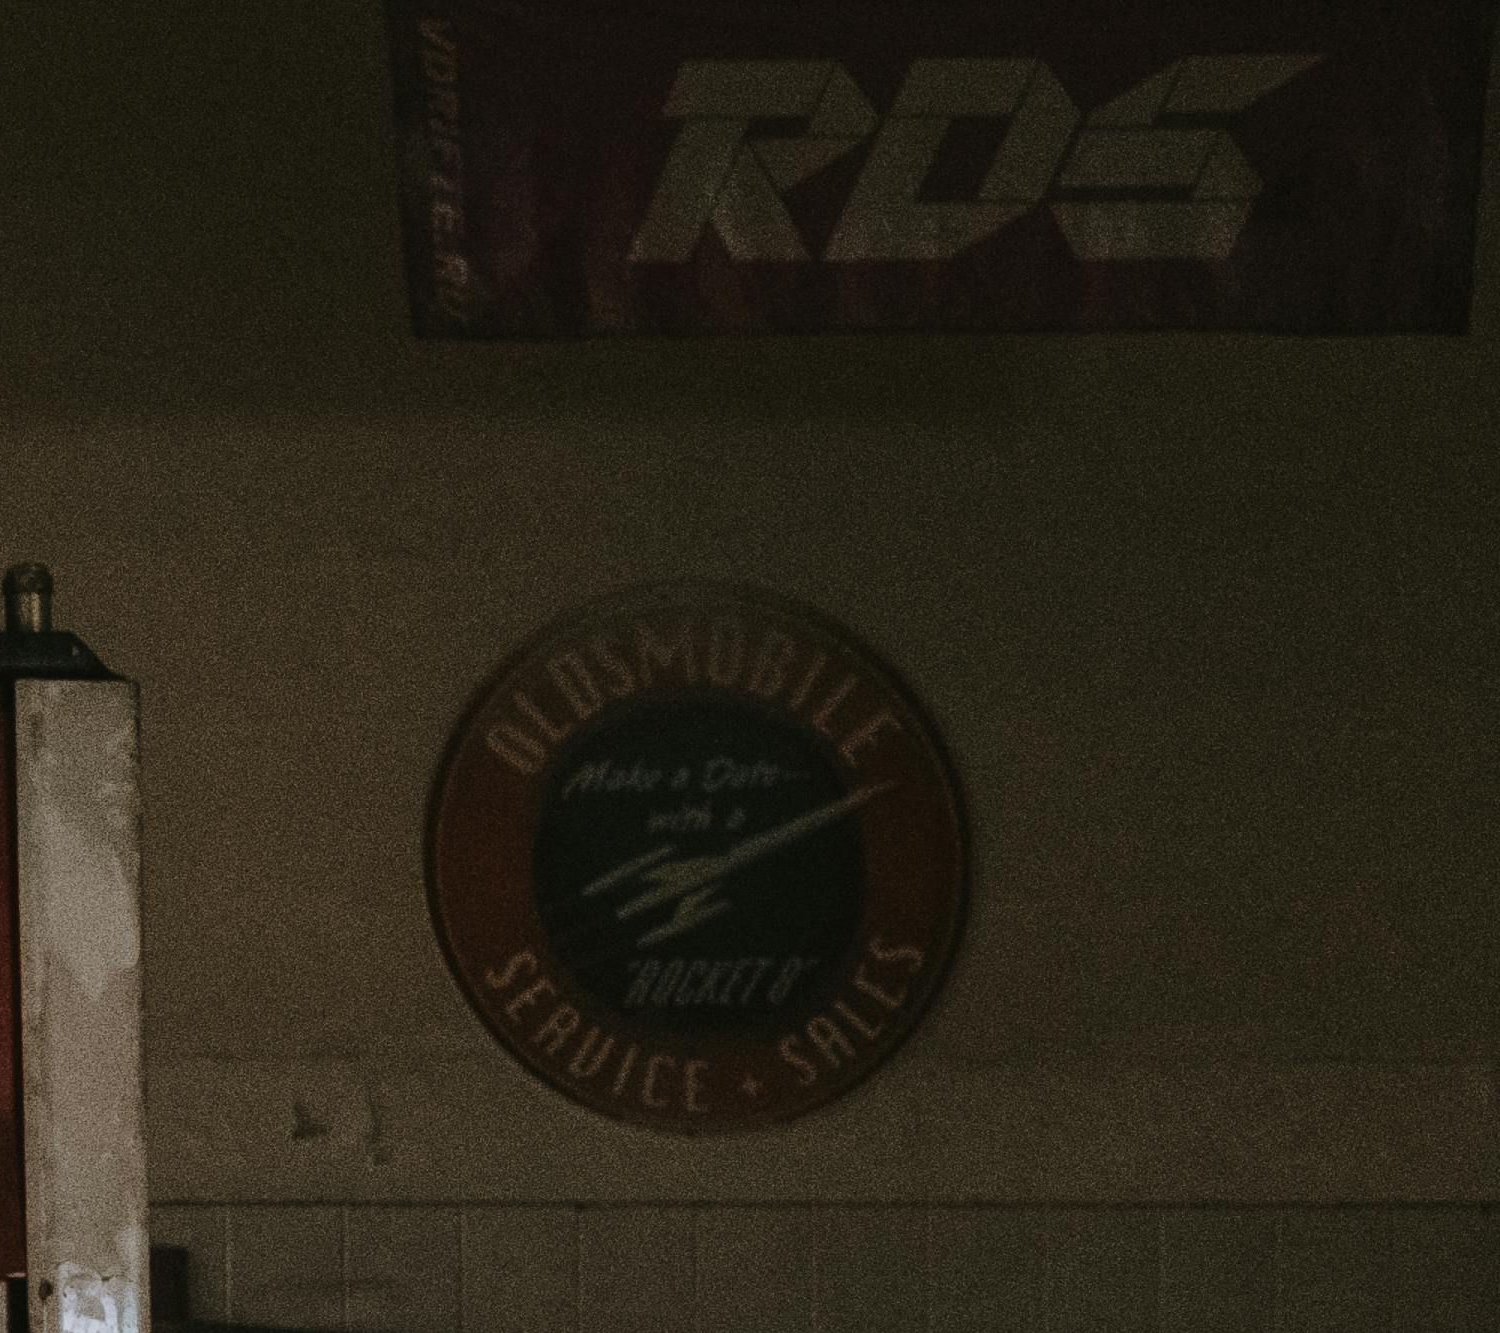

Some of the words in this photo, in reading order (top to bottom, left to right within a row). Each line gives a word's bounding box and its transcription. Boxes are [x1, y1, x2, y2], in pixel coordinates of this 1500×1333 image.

[627, 52, 1328, 262] RDS
[484, 613, 901, 777] OLDSMOBILE
[481, 947, 710, 1113] SERVICE
[778, 935, 925, 1086] SALES
